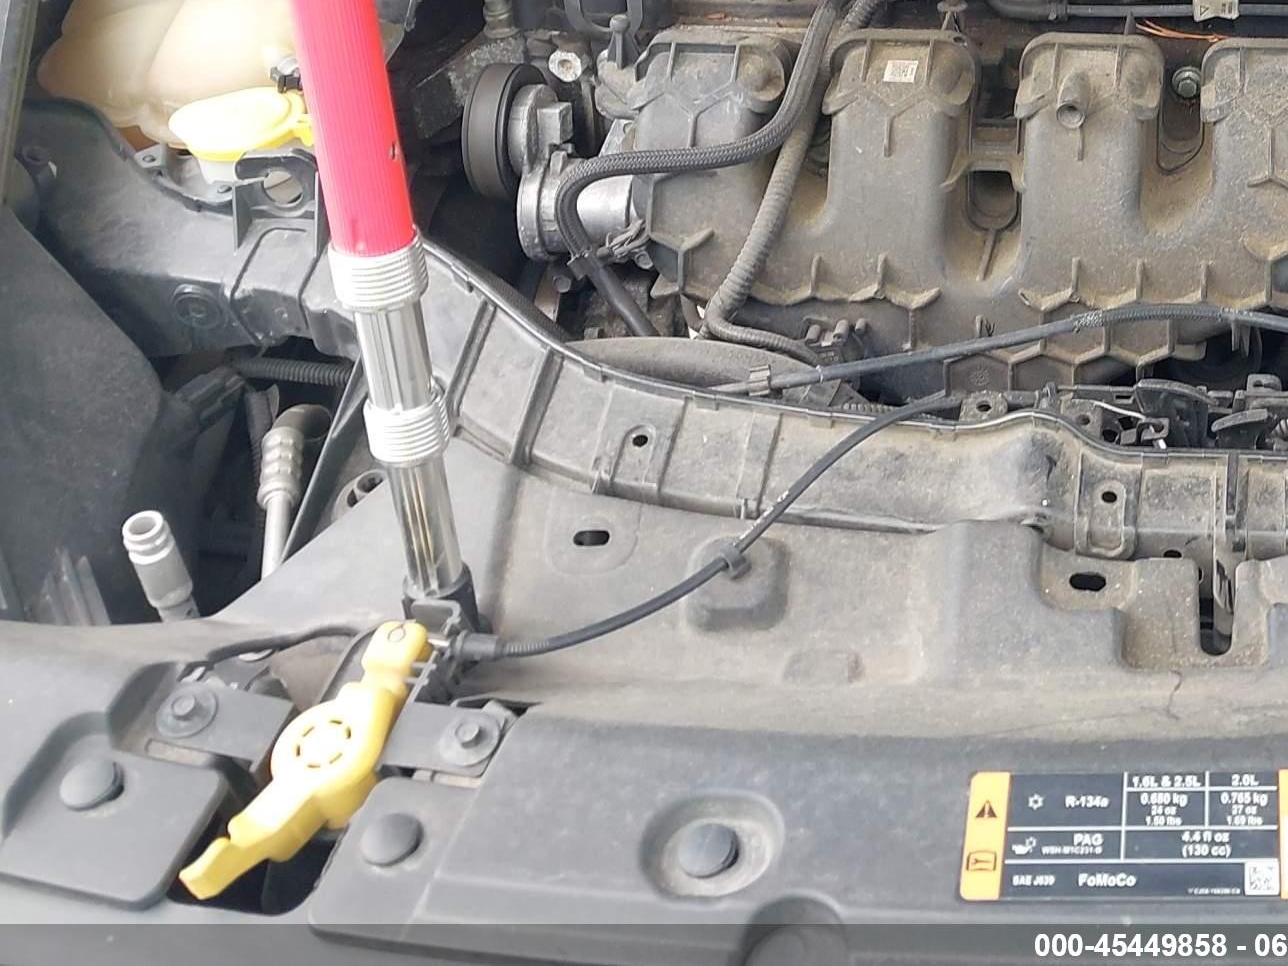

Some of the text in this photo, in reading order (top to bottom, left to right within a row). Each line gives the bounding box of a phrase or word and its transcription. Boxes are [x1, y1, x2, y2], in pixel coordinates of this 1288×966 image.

[1160, 775, 1172, 787] &
[1231, 774, 1260, 786] 2.0L
[1065, 795, 1110, 808] R-134a
[1172, 793, 1189, 808] kg
[1252, 792, 1269, 807] kg
[1073, 833, 1105, 846] PAG
[1181, 831, 1201, 843] 4.4
[1214, 832, 1231, 843] oz
[1182, 844, 1231, 858] (130 cc)
[1078, 873, 1137, 887] FoMoCo
